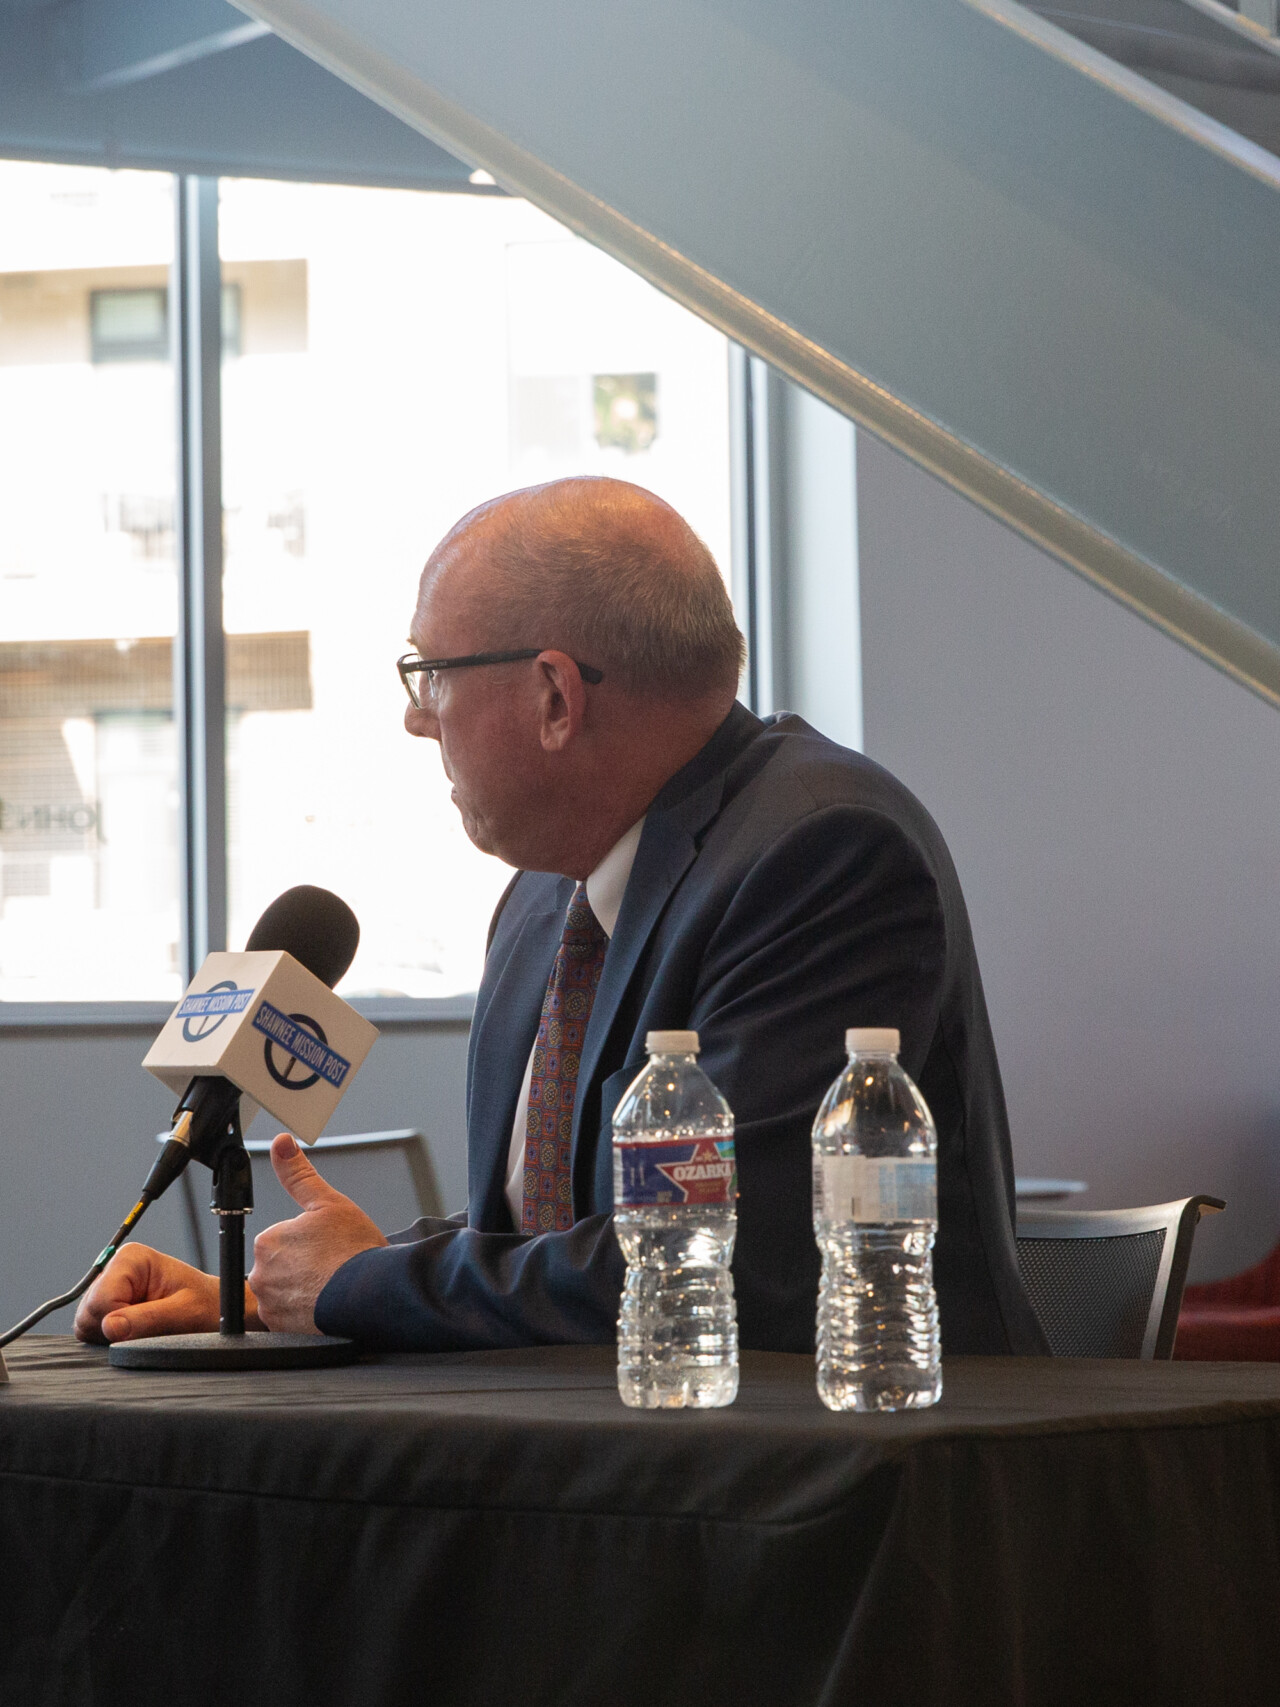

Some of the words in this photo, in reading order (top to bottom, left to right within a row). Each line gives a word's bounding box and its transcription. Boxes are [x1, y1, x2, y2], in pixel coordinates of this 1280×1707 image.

[179, 997, 212, 1016] SHAWNEE
[205, 994, 234, 1012] MISSION
[229, 991, 253, 1010] POST
[255, 1006, 296, 1045] SHAWNEE
[292, 1030, 327, 1067] MISSION
[322, 1055, 347, 1082] POST
